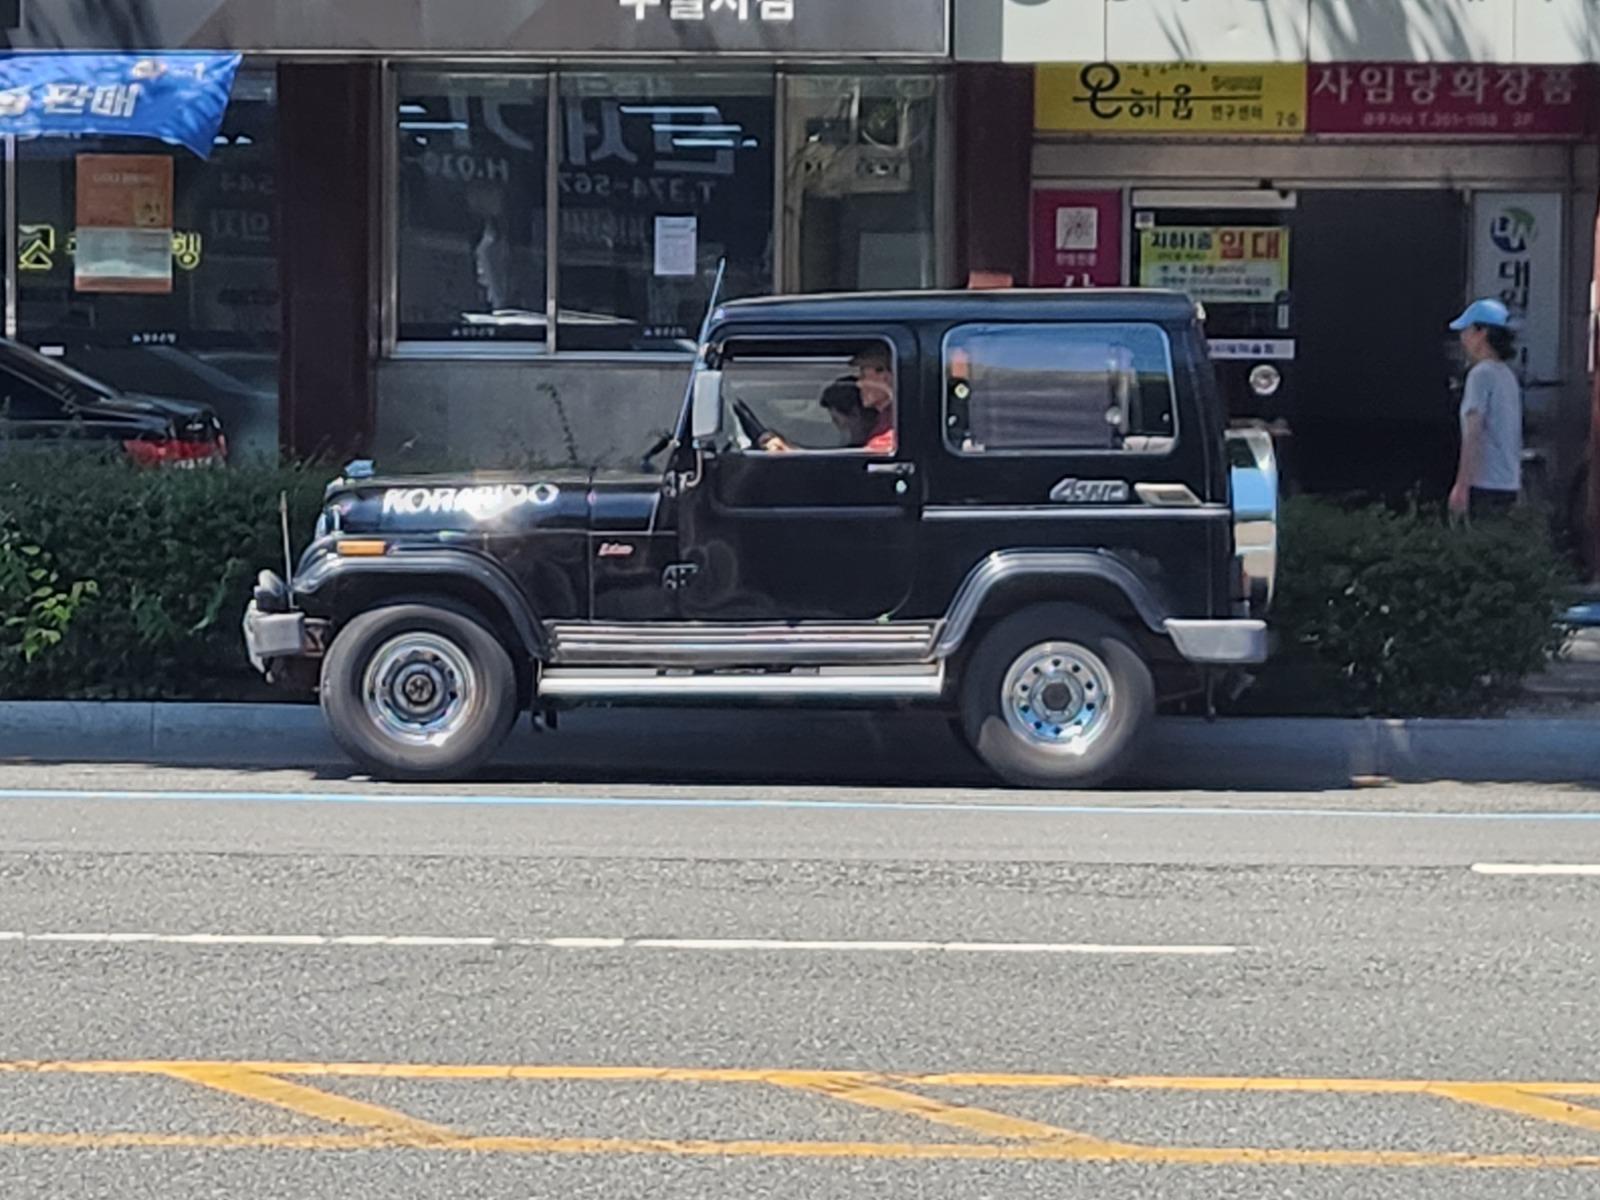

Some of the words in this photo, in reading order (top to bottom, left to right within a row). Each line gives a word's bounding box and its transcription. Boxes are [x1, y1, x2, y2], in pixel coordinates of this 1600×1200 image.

[39, 81, 139, 119] 판매
[1313, 66, 1573, 105] 사임당화장품
[1219, 231, 1281, 260] 임대
